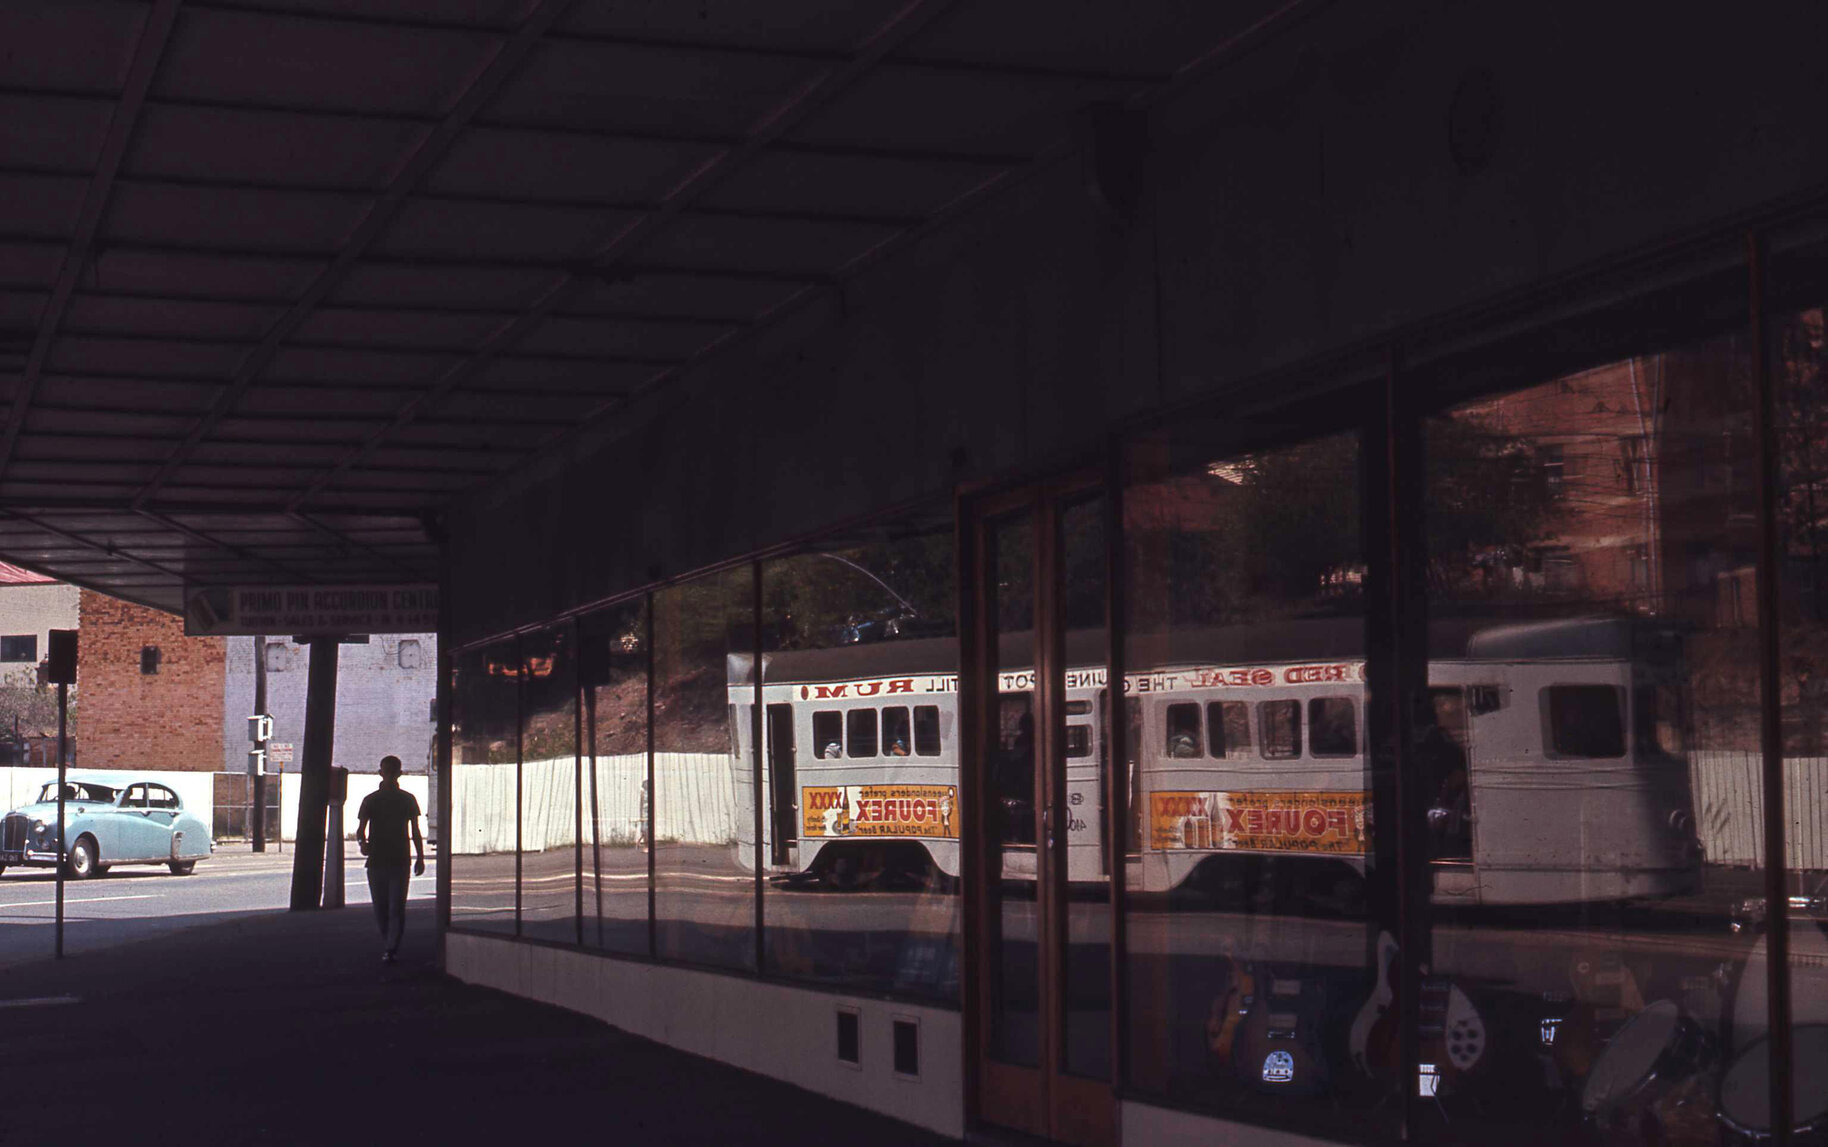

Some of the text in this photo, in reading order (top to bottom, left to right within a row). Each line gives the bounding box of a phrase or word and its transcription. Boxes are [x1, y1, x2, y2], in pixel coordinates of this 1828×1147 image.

[240, 591, 282, 611] PRIMO
[314, 590, 388, 610] ACCORDION
[284, 614, 314, 626] SALES
[330, 614, 372, 626] SERVICE
